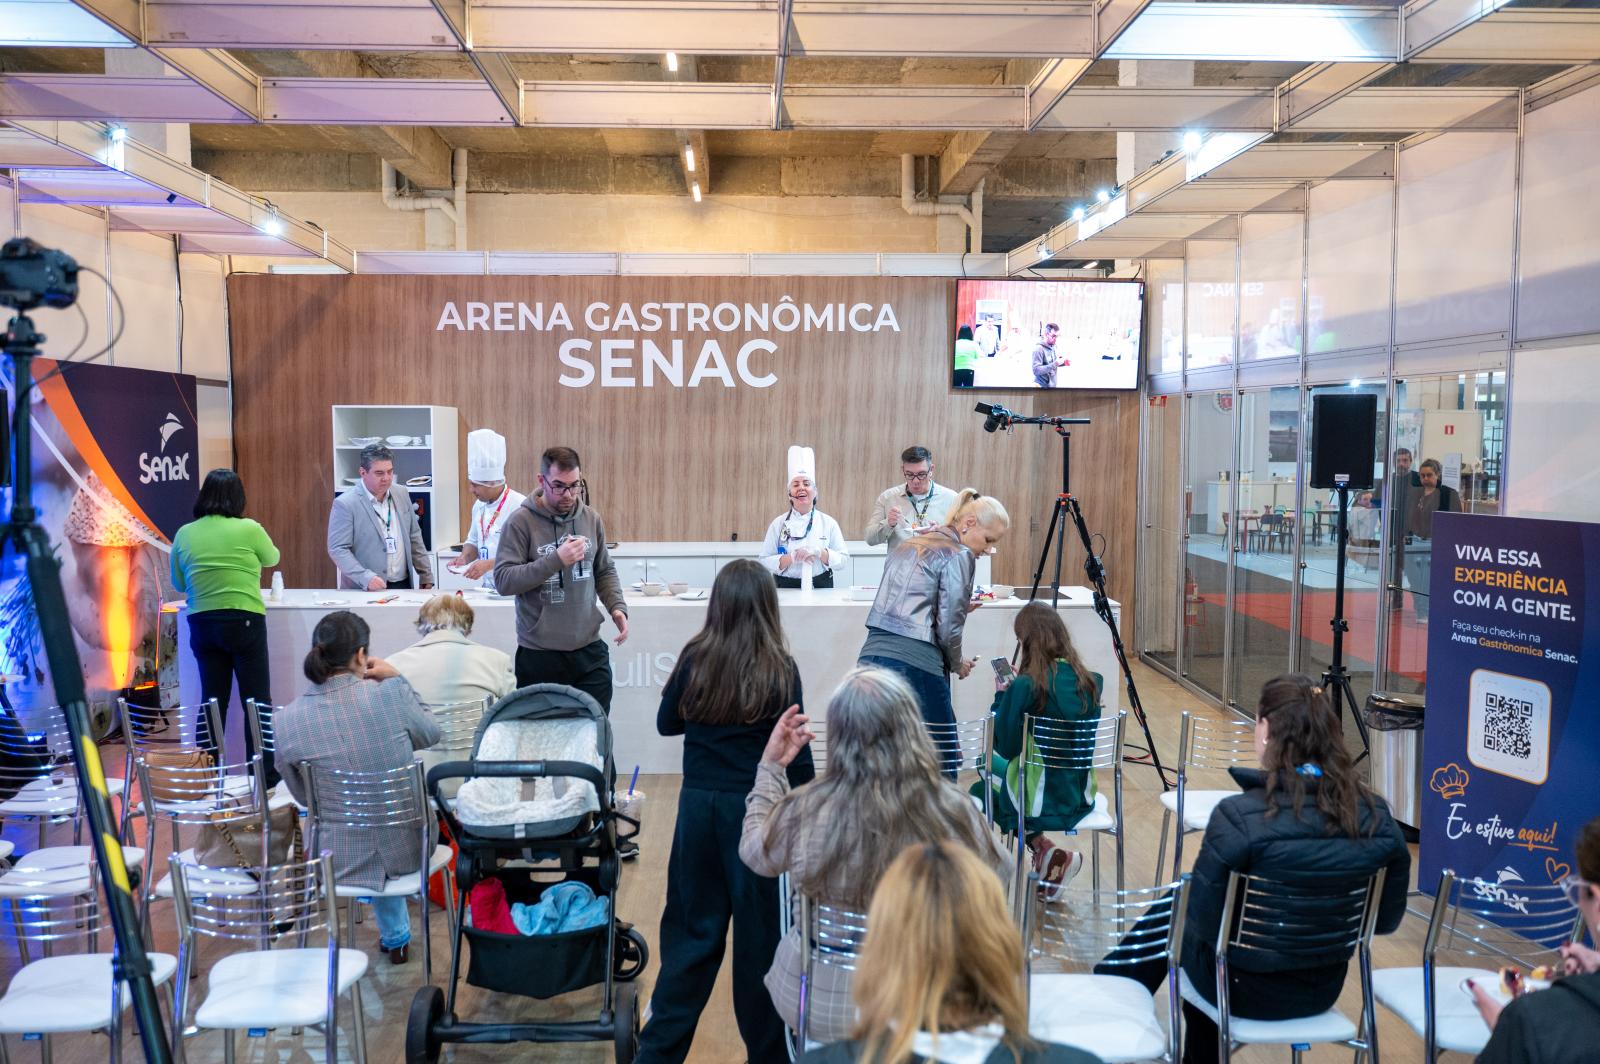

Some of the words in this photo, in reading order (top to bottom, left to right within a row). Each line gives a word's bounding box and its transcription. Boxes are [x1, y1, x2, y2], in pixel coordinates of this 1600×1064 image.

[1036, 282, 1096, 297] SENAC
[436, 301, 574, 332] ARENA
[584, 295, 901, 332] GASTRONÔMICA
[558, 338, 778, 388] SENAC
[1454, 544, 1493, 563] VIVA
[1497, 548, 1542, 568] ESSA
[1454, 566, 1569, 596] EXPERIÊNCIA
[1453, 589, 1490, 609] COM
[1494, 595, 1508, 612] A
[1511, 597, 1576, 622] GENTE.
[1452, 619, 1471, 632] Faça
[1472, 623, 1488, 634] seu
[1489, 625, 1527, 641] check-in
[1529, 632, 1541, 643] na
[1451, 632, 1477, 645] Arena
[1544, 649, 1578, 664] Senac.
[1446, 802, 1472, 840] Eu
[1475, 814, 1515, 845] estive
[1517, 821, 1557, 852] aqui!
